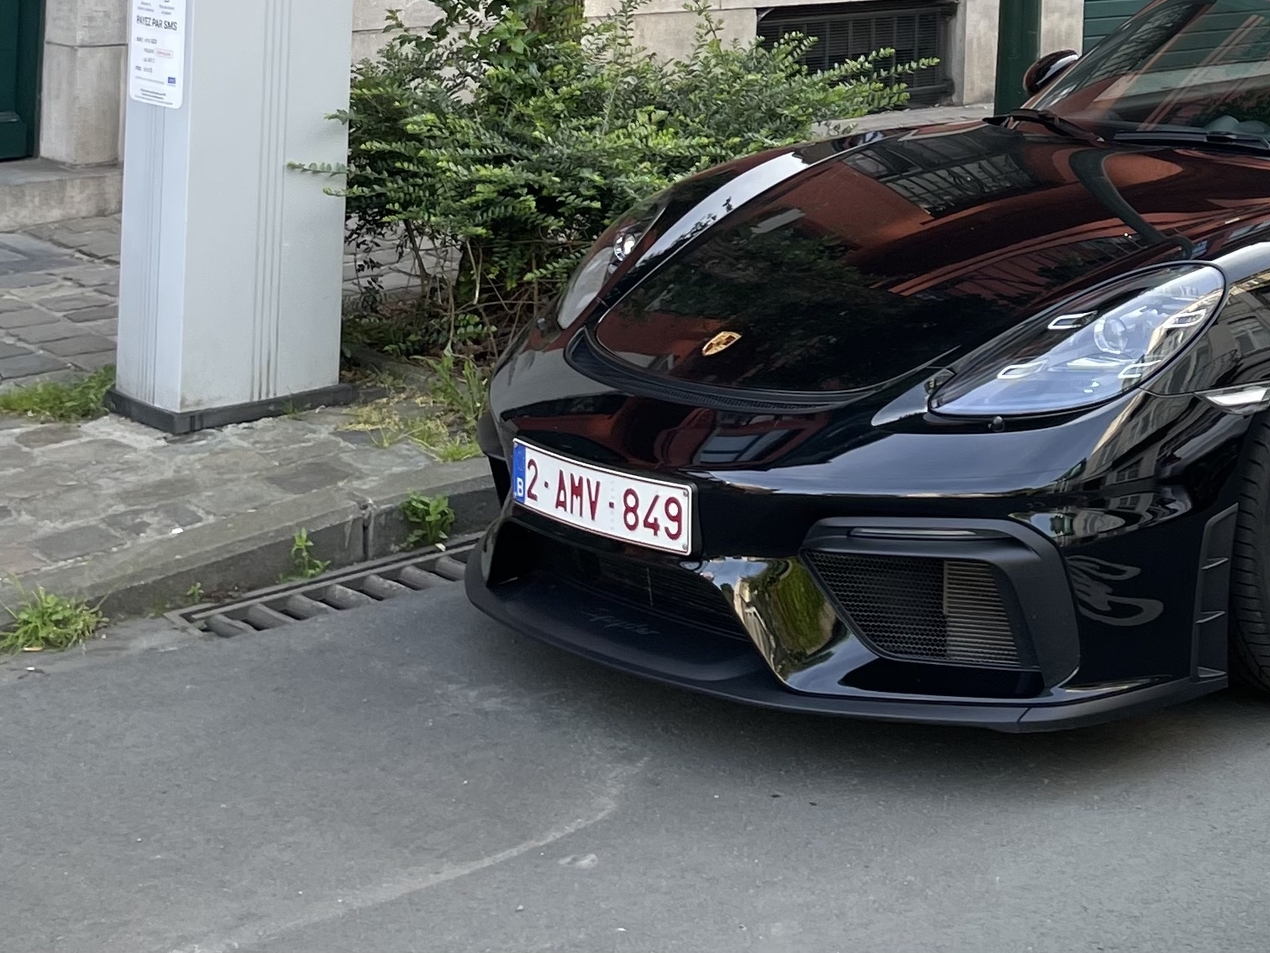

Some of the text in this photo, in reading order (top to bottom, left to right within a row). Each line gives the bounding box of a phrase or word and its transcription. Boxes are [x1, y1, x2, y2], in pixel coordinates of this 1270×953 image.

[136, 14, 178, 31] PAYEZ PAR SMS
[516, 477, 525, 497] B
